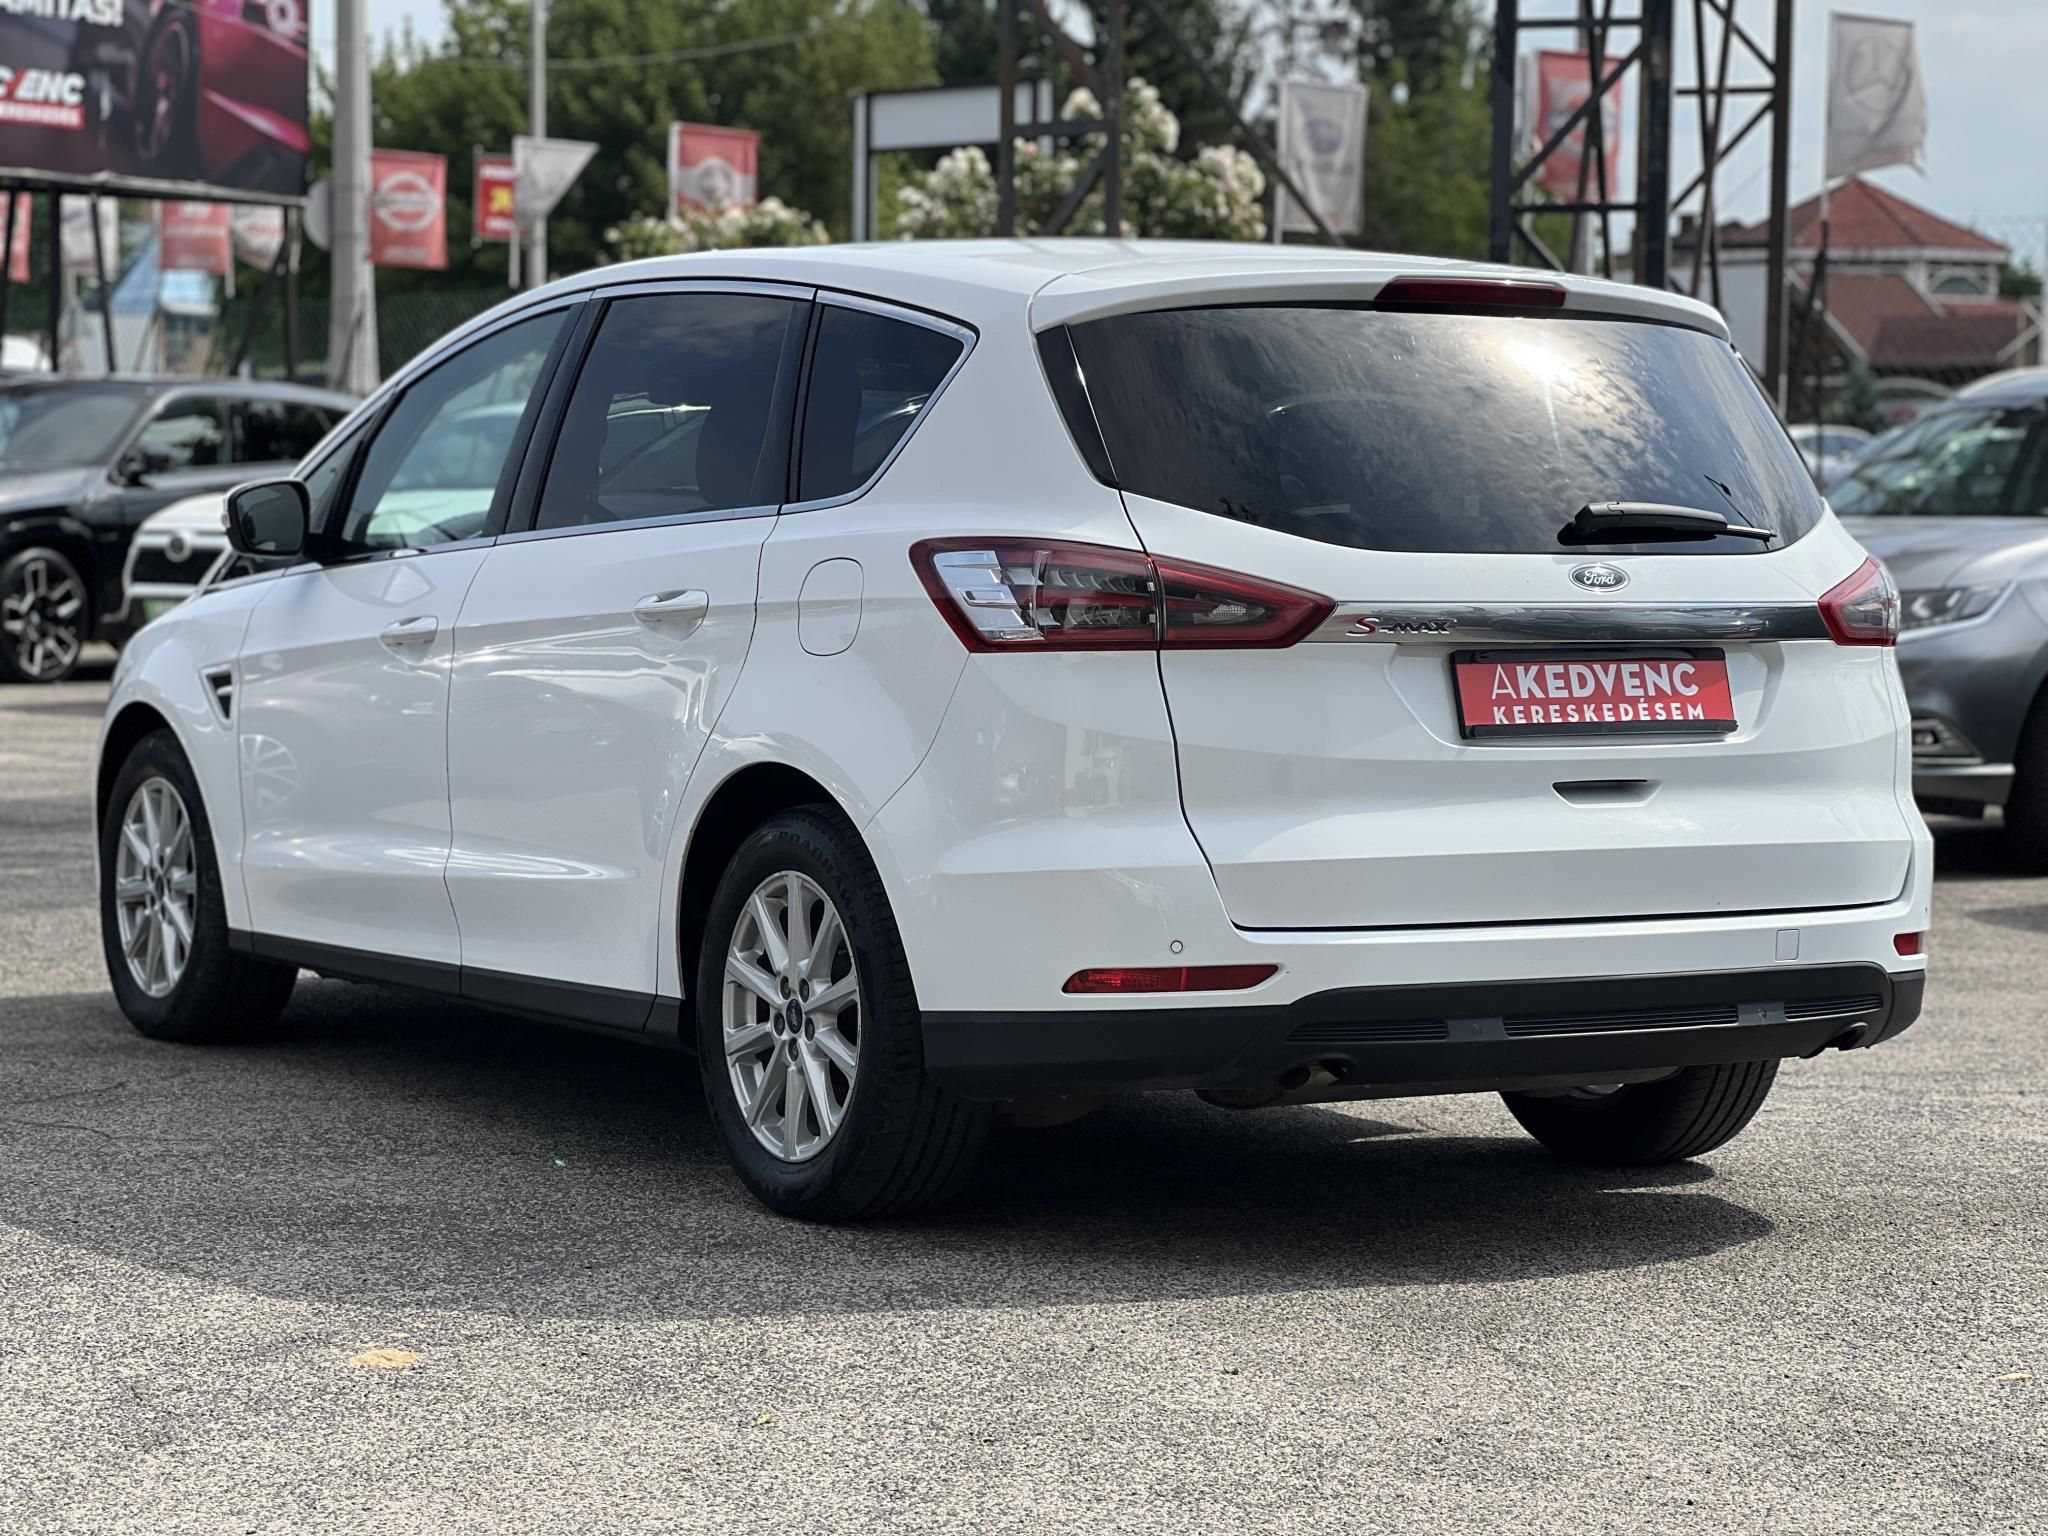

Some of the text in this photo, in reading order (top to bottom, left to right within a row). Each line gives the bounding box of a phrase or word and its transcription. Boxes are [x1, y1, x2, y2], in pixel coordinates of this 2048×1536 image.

[1583, 569, 1616, 585] Ford
[1345, 617, 1451, 637] S-MAX
[1493, 698, 1705, 725] KERESKEDÉSEM
